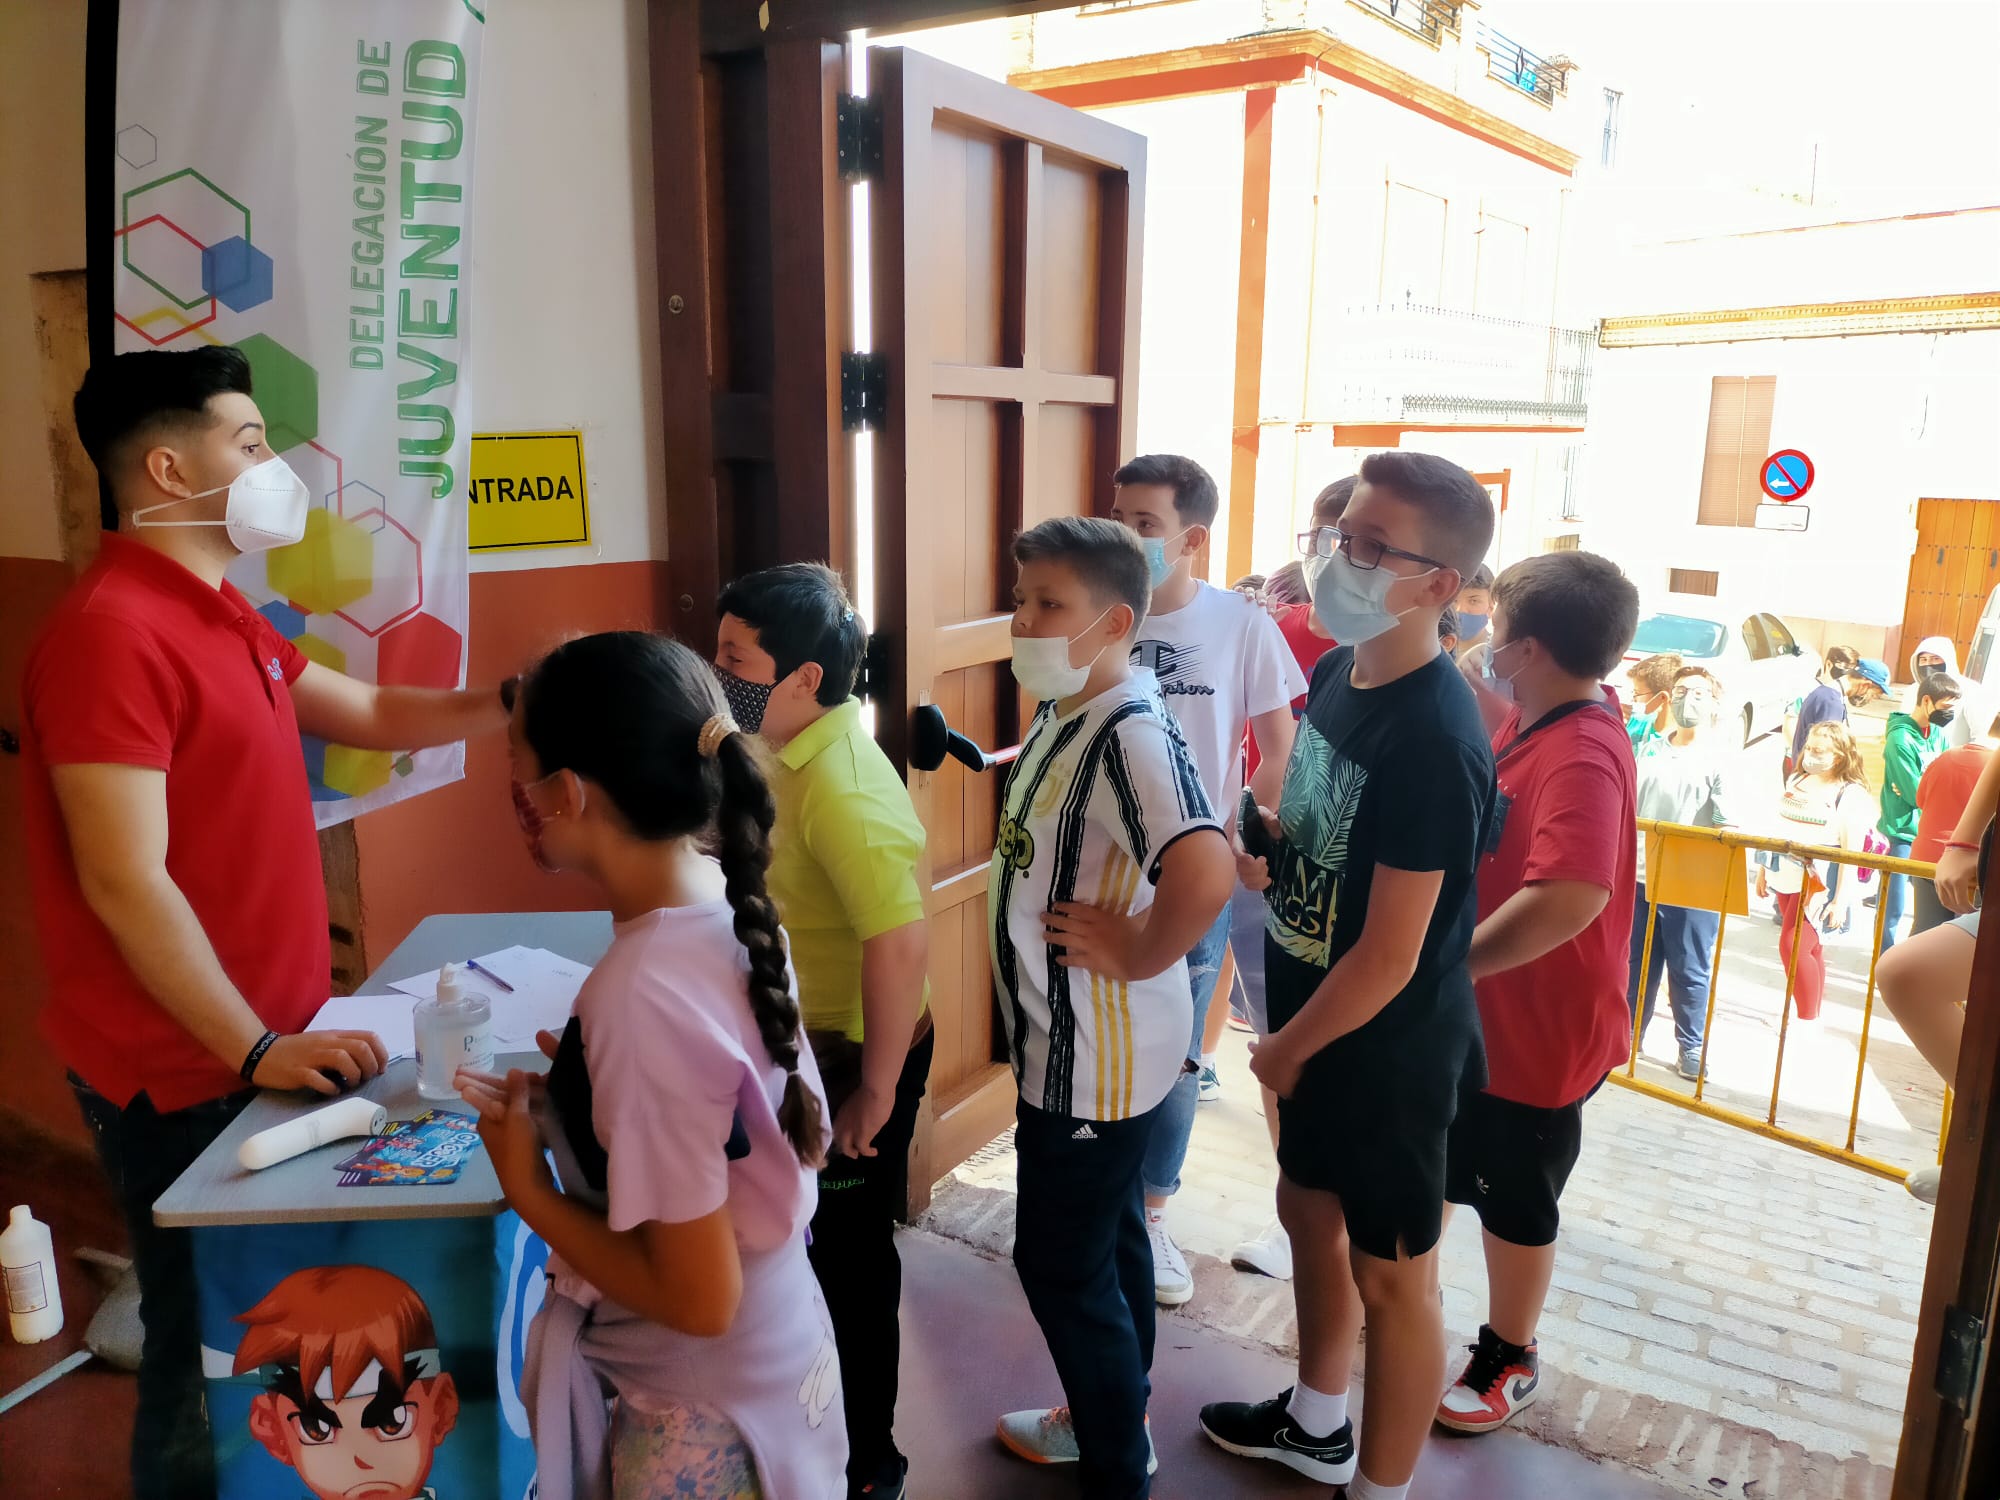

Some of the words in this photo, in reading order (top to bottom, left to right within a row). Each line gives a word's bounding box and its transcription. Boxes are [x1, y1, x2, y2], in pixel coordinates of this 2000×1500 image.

[356, 39, 391, 96] DE
[347, 115, 389, 370] DELEGACIÓN
[397, 38, 467, 499] JUVENTUD
[468, 475, 575, 504] NTRADA
